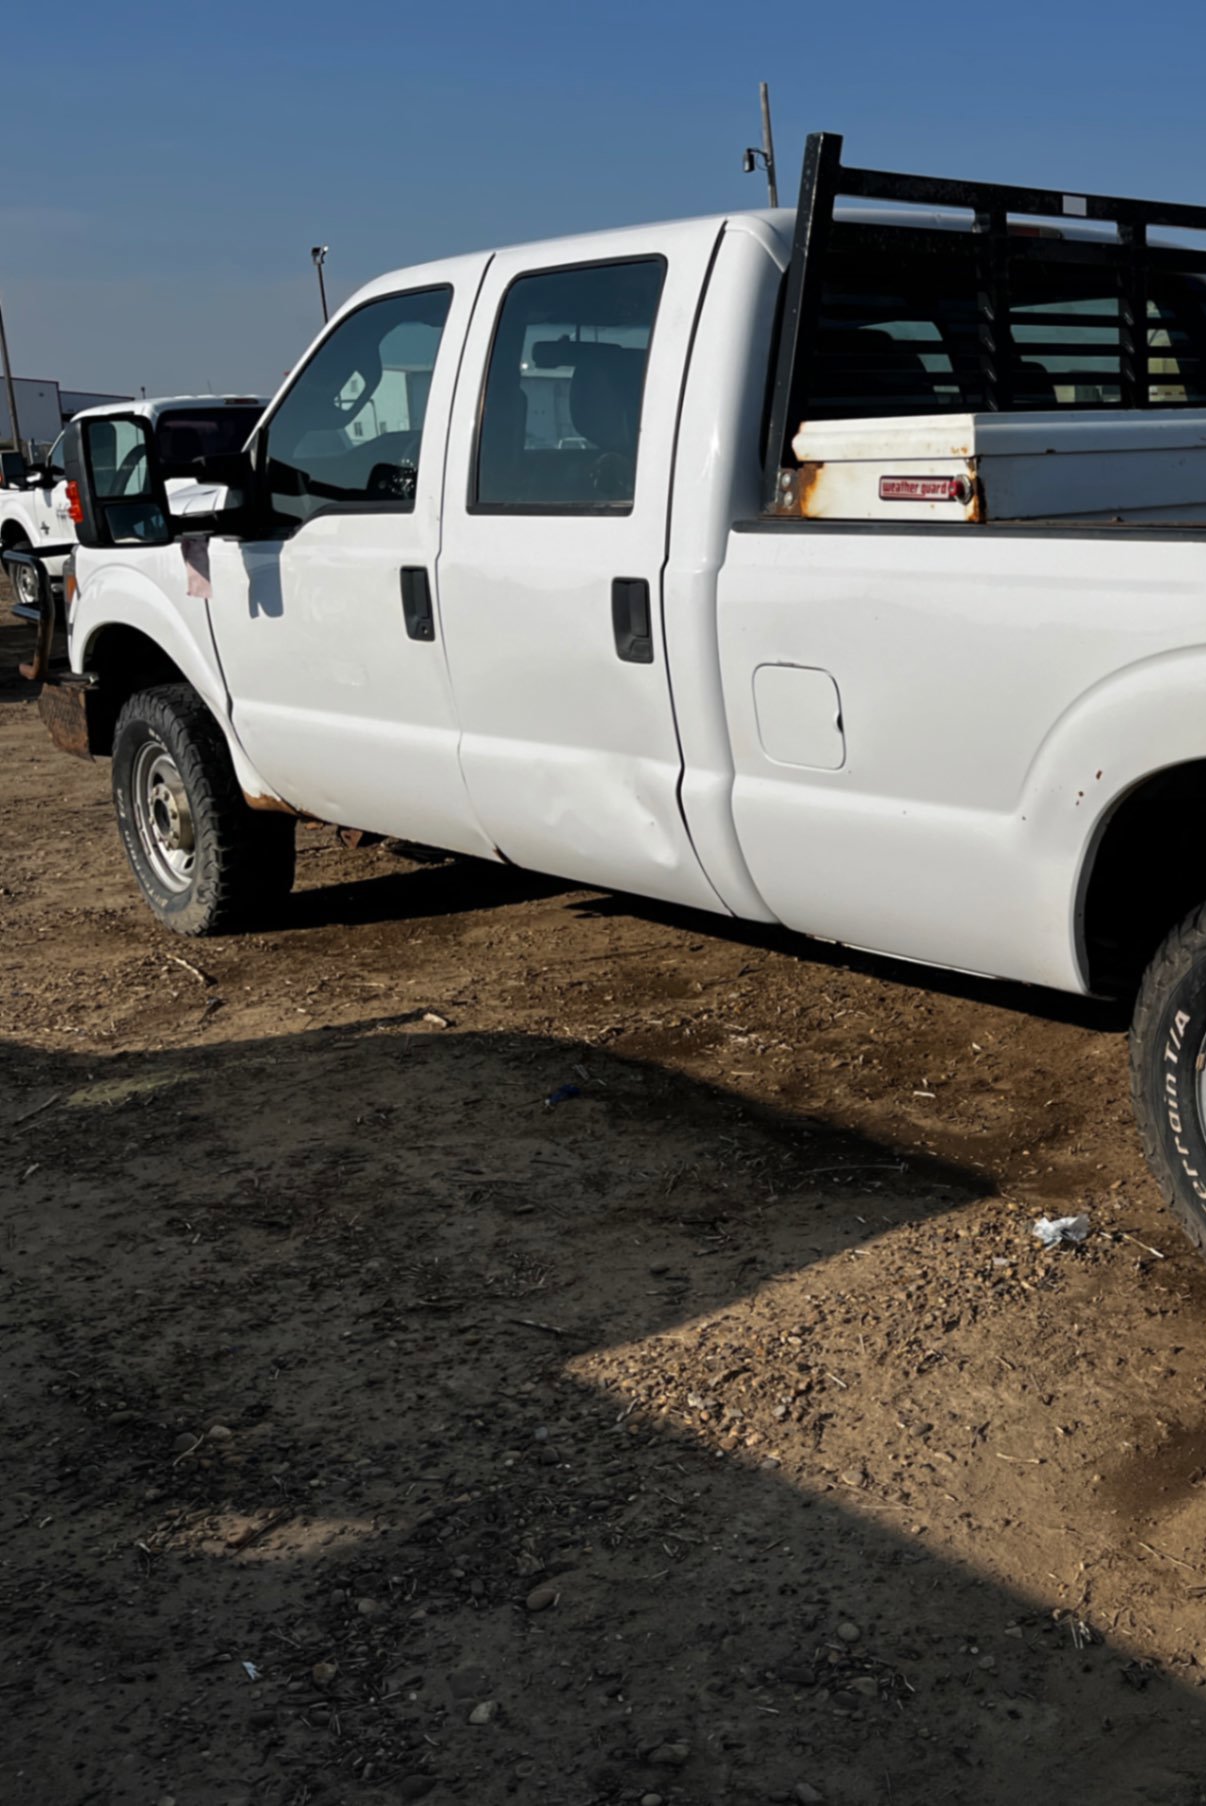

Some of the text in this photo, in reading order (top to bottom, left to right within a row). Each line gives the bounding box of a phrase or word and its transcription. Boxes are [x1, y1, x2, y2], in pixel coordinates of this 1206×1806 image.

[882, 480, 947, 494] weather guard
[1163, 1008, 1191, 1065] T/A
